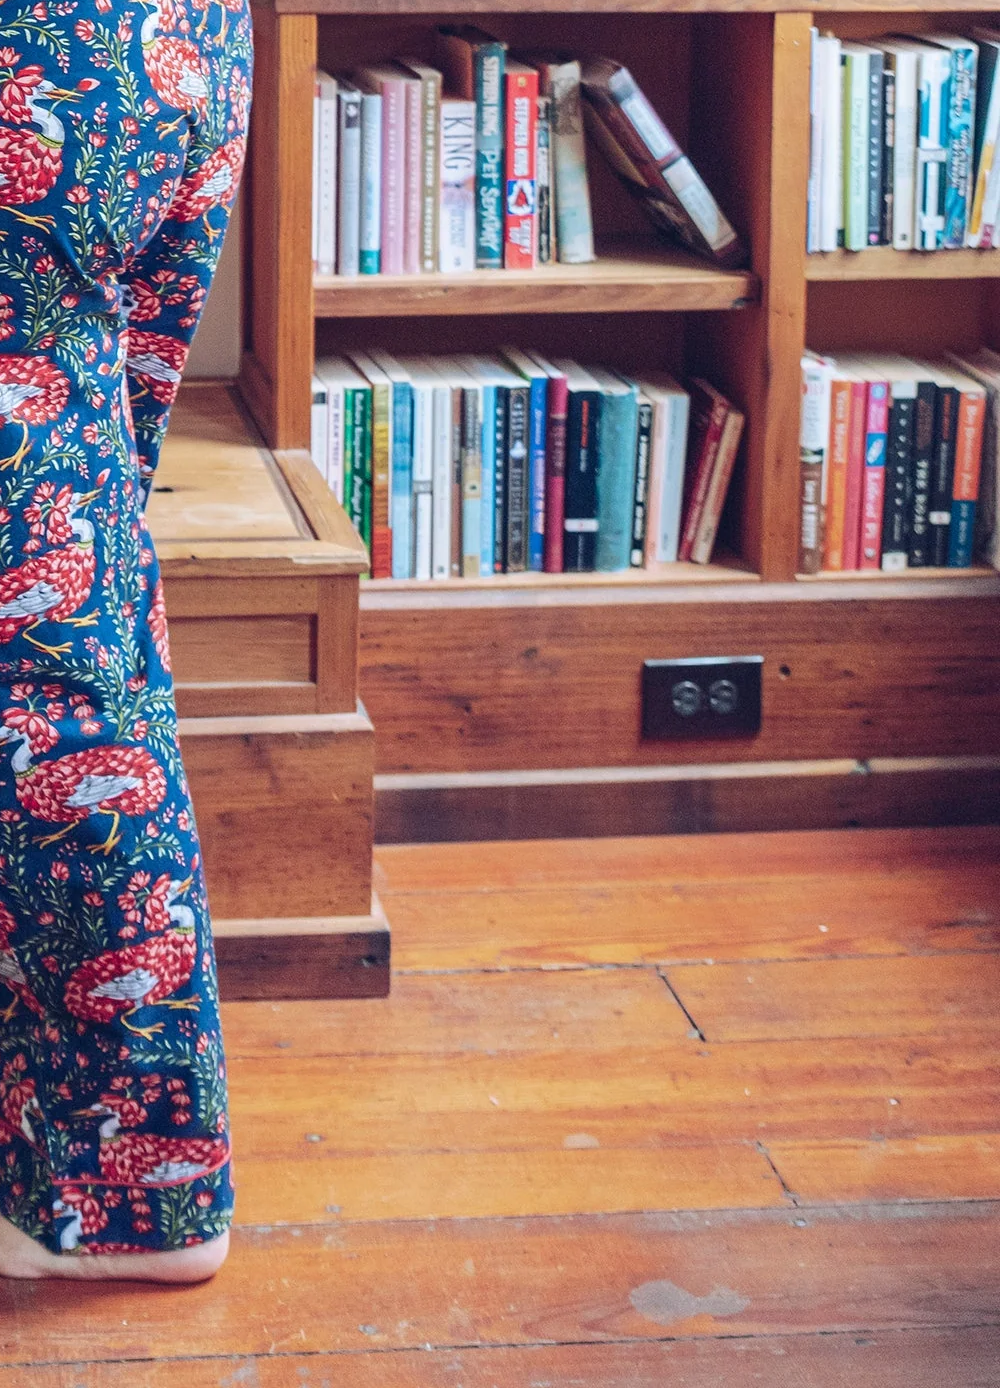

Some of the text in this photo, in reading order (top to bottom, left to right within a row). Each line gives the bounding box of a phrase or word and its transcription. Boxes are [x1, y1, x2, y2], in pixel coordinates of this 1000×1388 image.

[482, 56, 499, 104] STEPHEN
[442, 115, 471, 170] KING
[482, 105, 499, 137] KING
[513, 97, 530, 176] STEPHEN KING
[479, 149, 501, 185] PET
